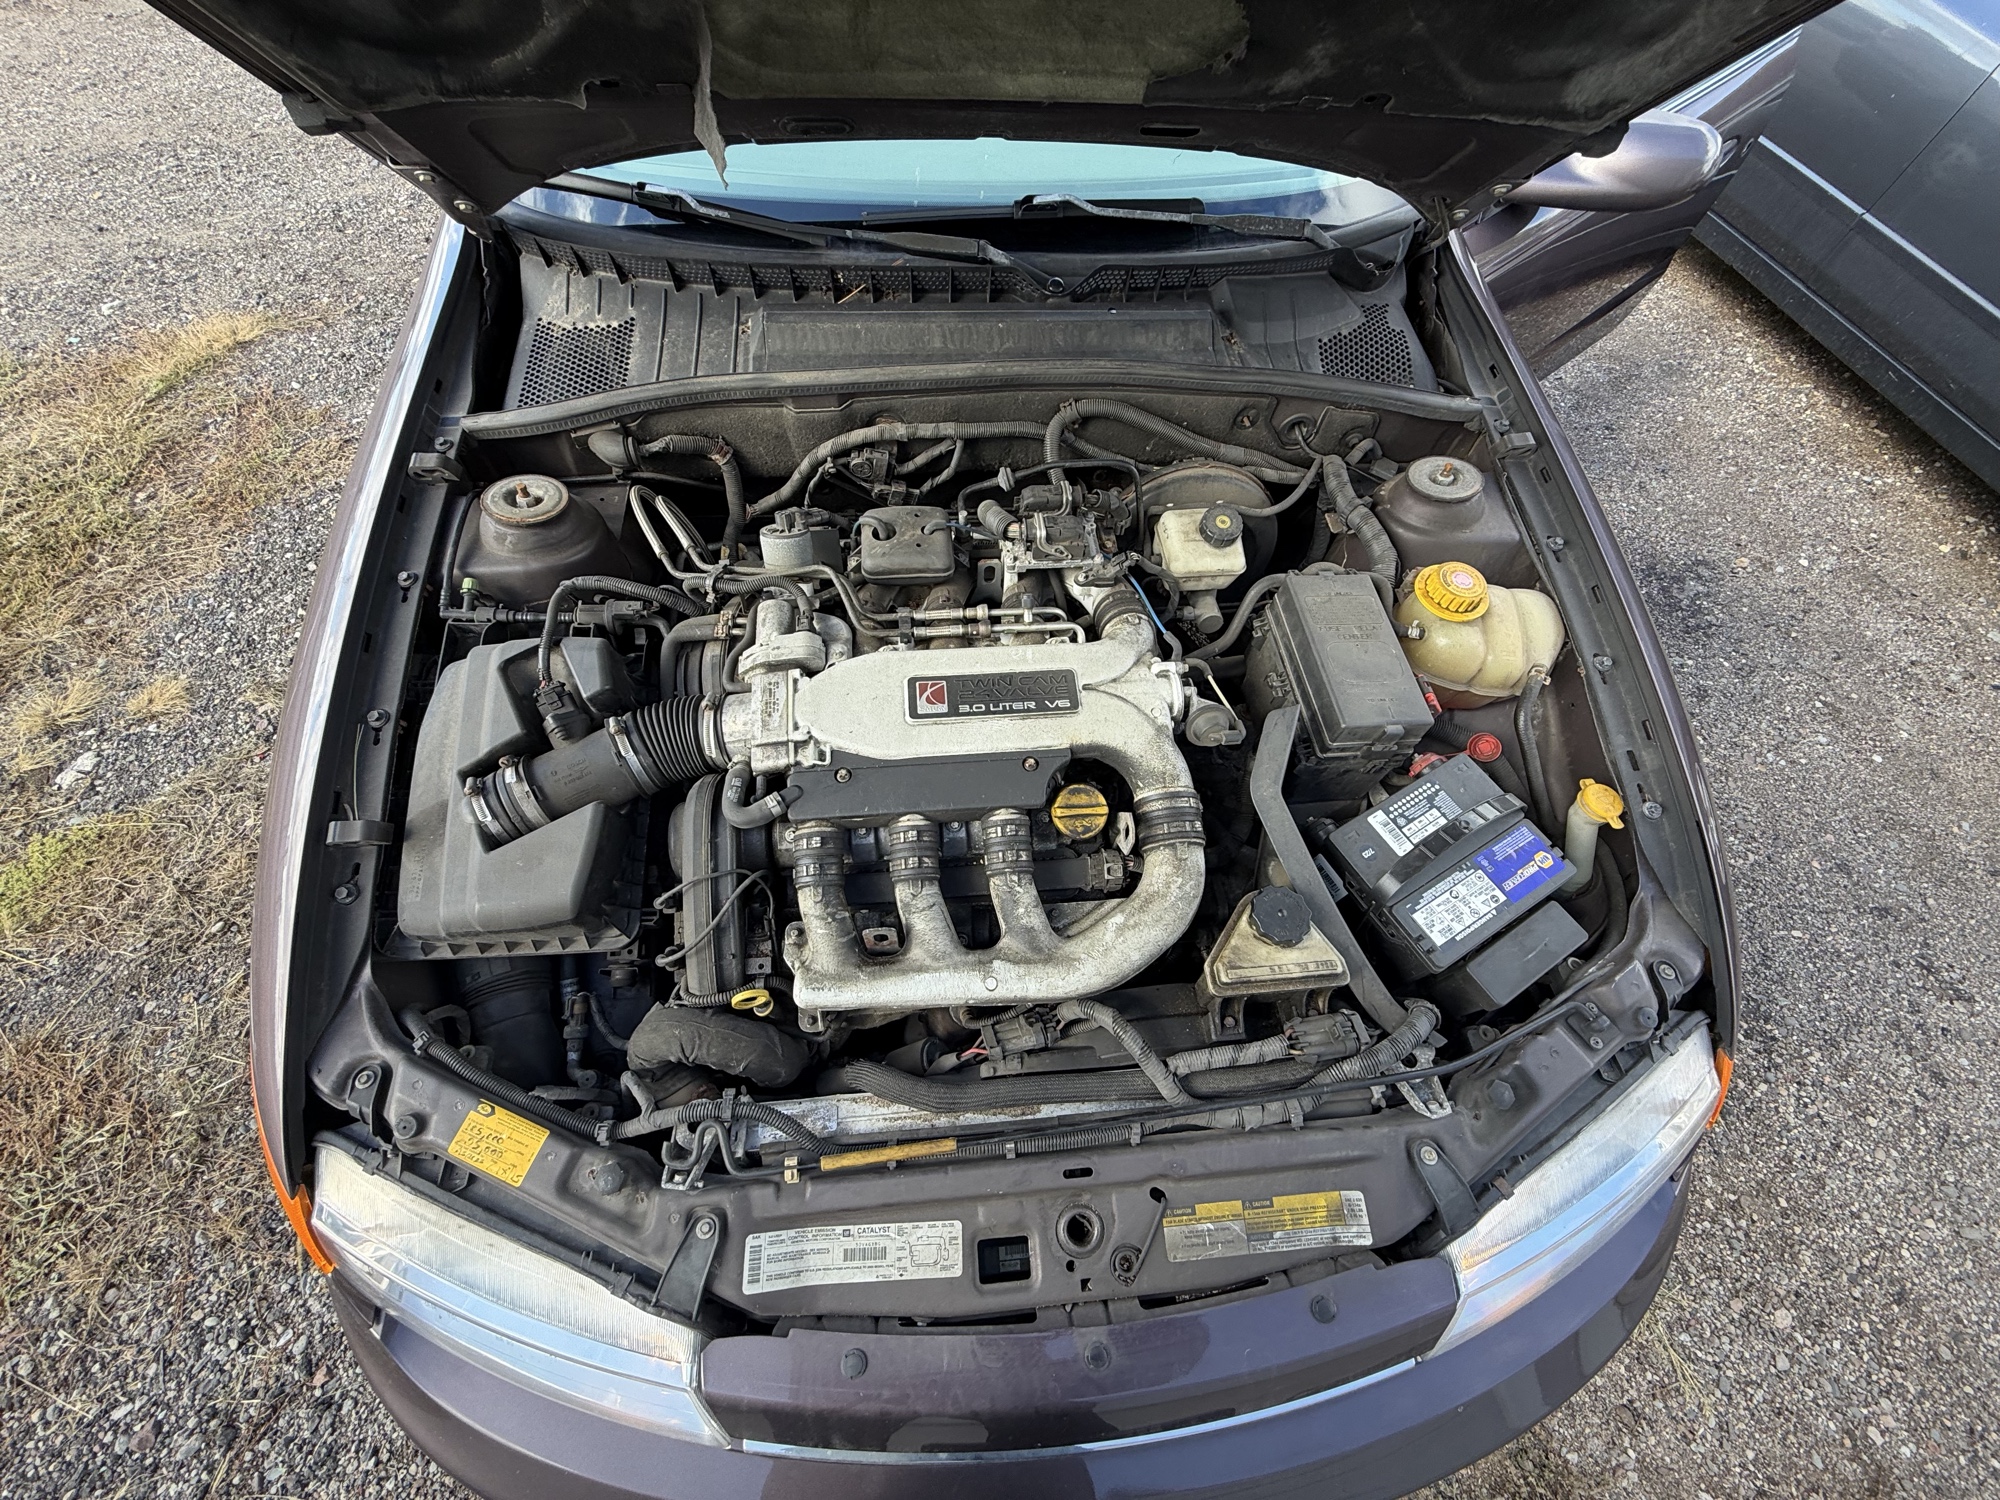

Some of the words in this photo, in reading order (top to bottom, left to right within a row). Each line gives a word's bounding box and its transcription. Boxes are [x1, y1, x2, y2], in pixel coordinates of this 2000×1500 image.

[954, 677, 1012, 690] TWIN
[1019, 674, 1067, 686] CAM
[990, 685, 1069, 697] VALVE
[959, 704, 985, 712] 3.0
[990, 701, 1036, 711] LITER
[1045, 699, 1070, 708] V6
[857, 1226, 891, 1234] CATALYST
